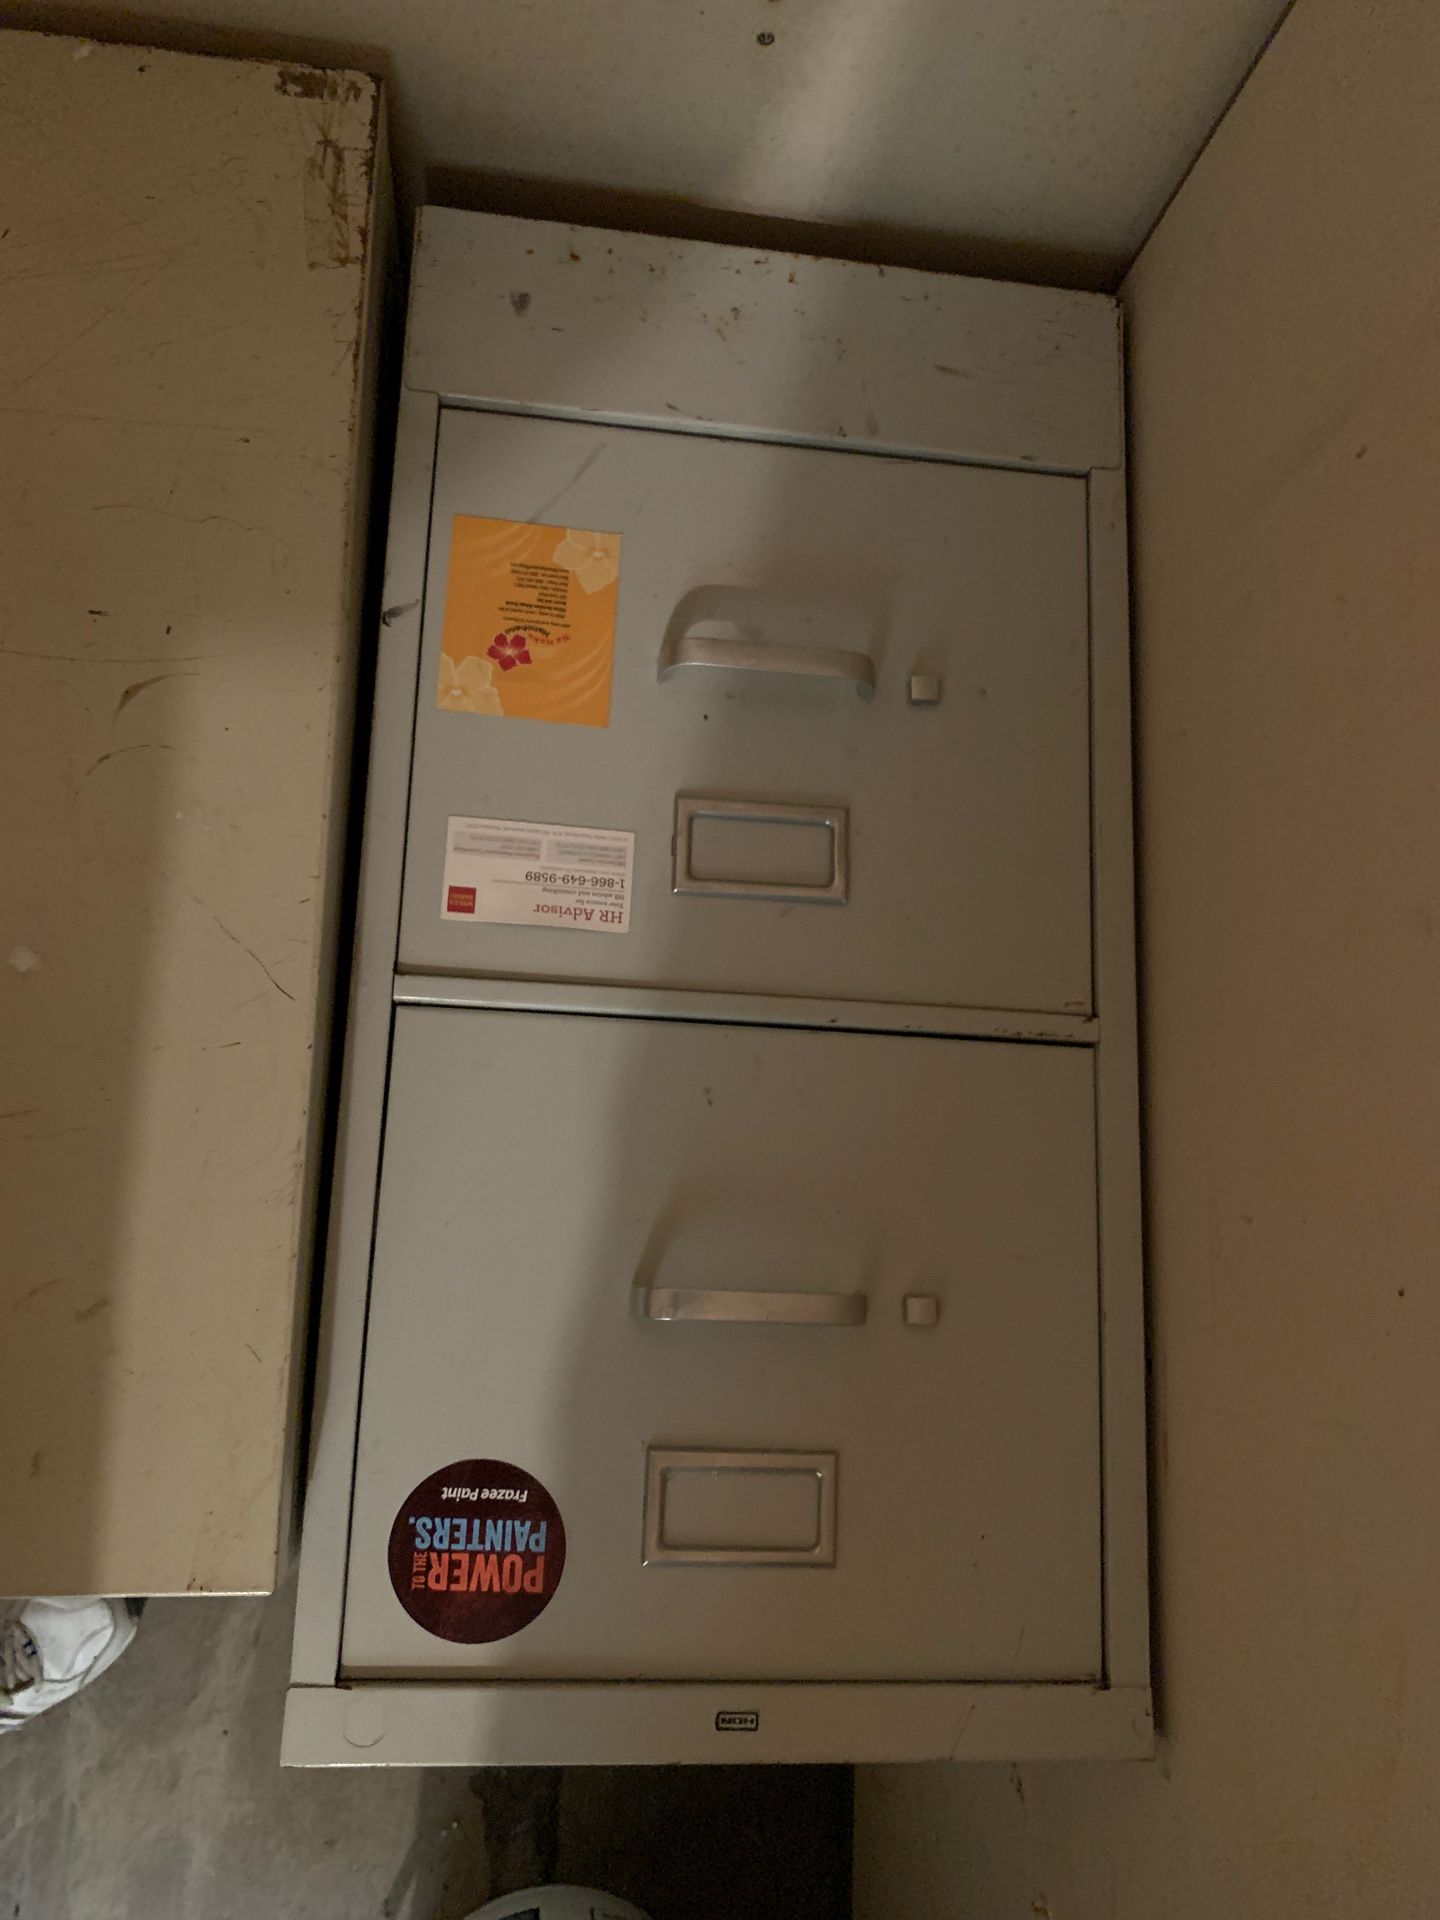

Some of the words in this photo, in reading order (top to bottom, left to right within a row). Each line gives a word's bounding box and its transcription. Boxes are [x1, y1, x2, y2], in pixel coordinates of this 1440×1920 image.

[525, 871, 625, 889] 1-866-649-9589
[533, 904, 595, 921] Advisor
[599, 910, 624, 924] HR
[441, 1487, 479, 1502] Paint
[480, 1488, 528, 1503] Frazee
[408, 1516, 547, 1553] PAINTERS.
[412, 1551, 427, 1573] THE
[428, 1552, 545, 1594] POWER
[411, 1575, 425, 1590] TO
